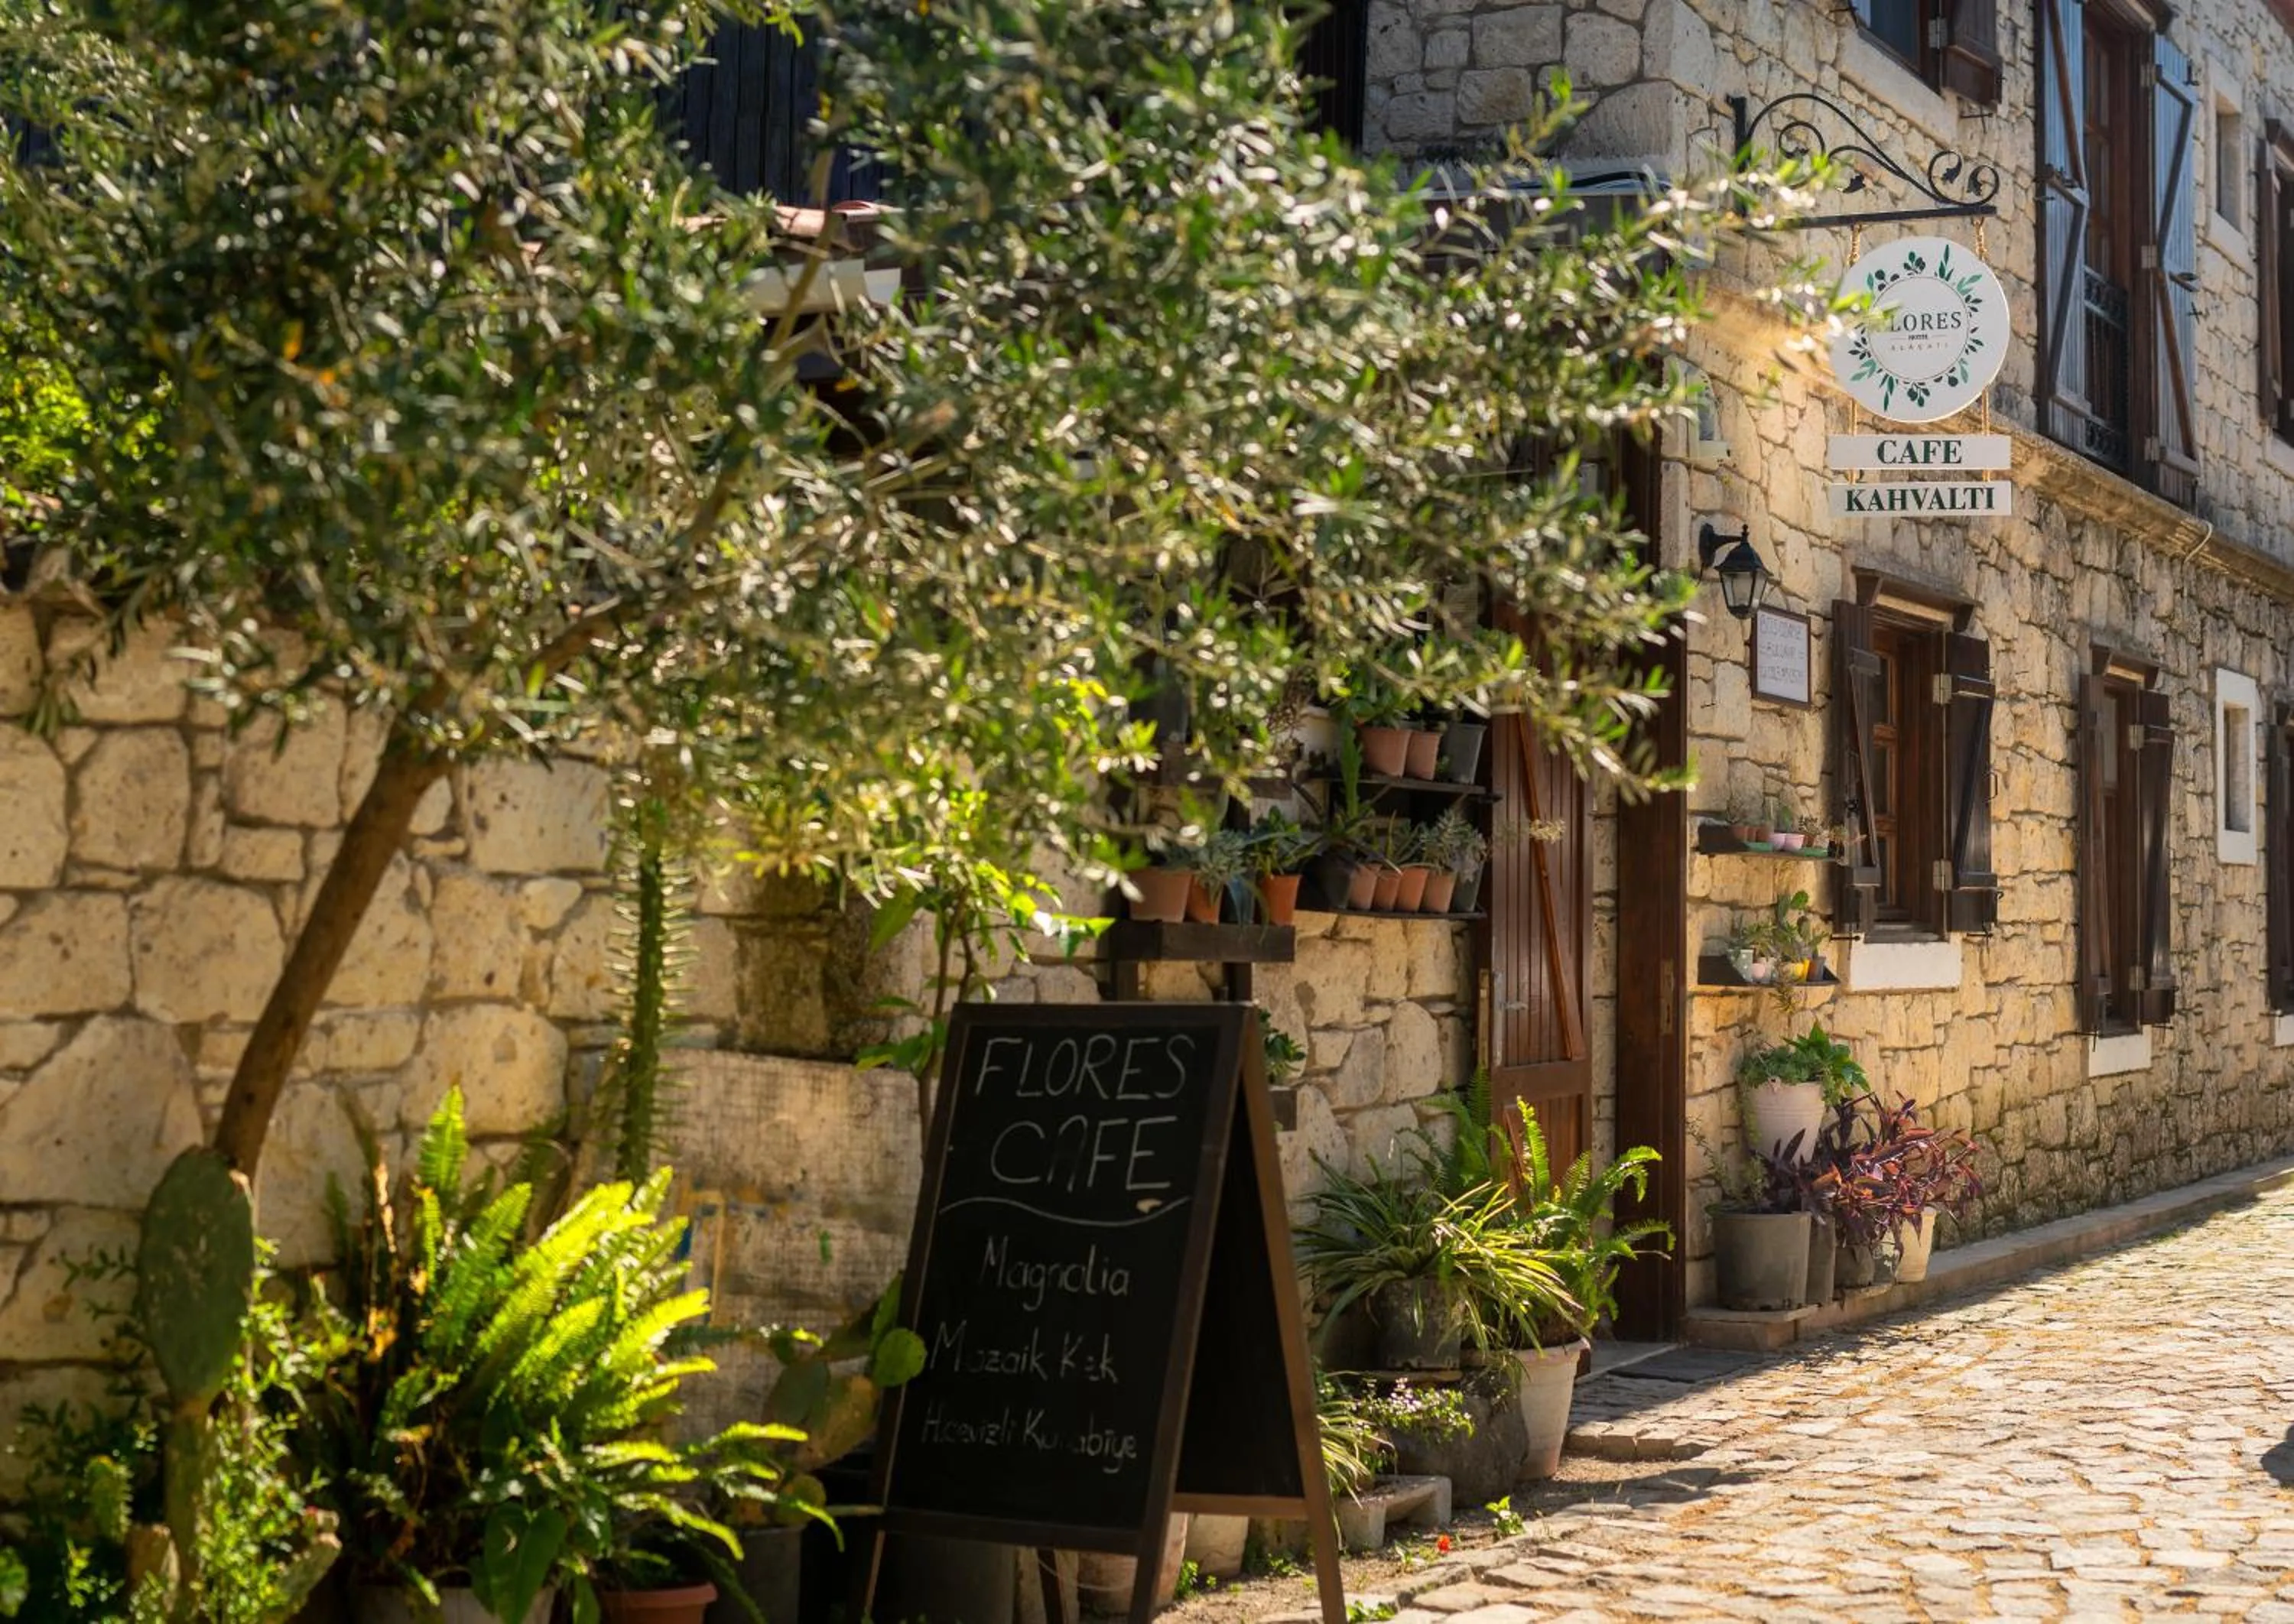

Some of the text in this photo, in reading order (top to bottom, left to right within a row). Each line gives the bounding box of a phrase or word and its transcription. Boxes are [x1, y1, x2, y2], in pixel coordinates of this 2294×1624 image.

[1884, 311, 1961, 332] LORES
[1877, 440, 1962, 464] CAFE
[1845, 487, 1995, 512] KAHVALTI
[975, 1034, 1196, 1099] FLORES
[990, 1114, 1178, 1190] CAFE
[978, 1235, 1130, 1311] Magnolia
